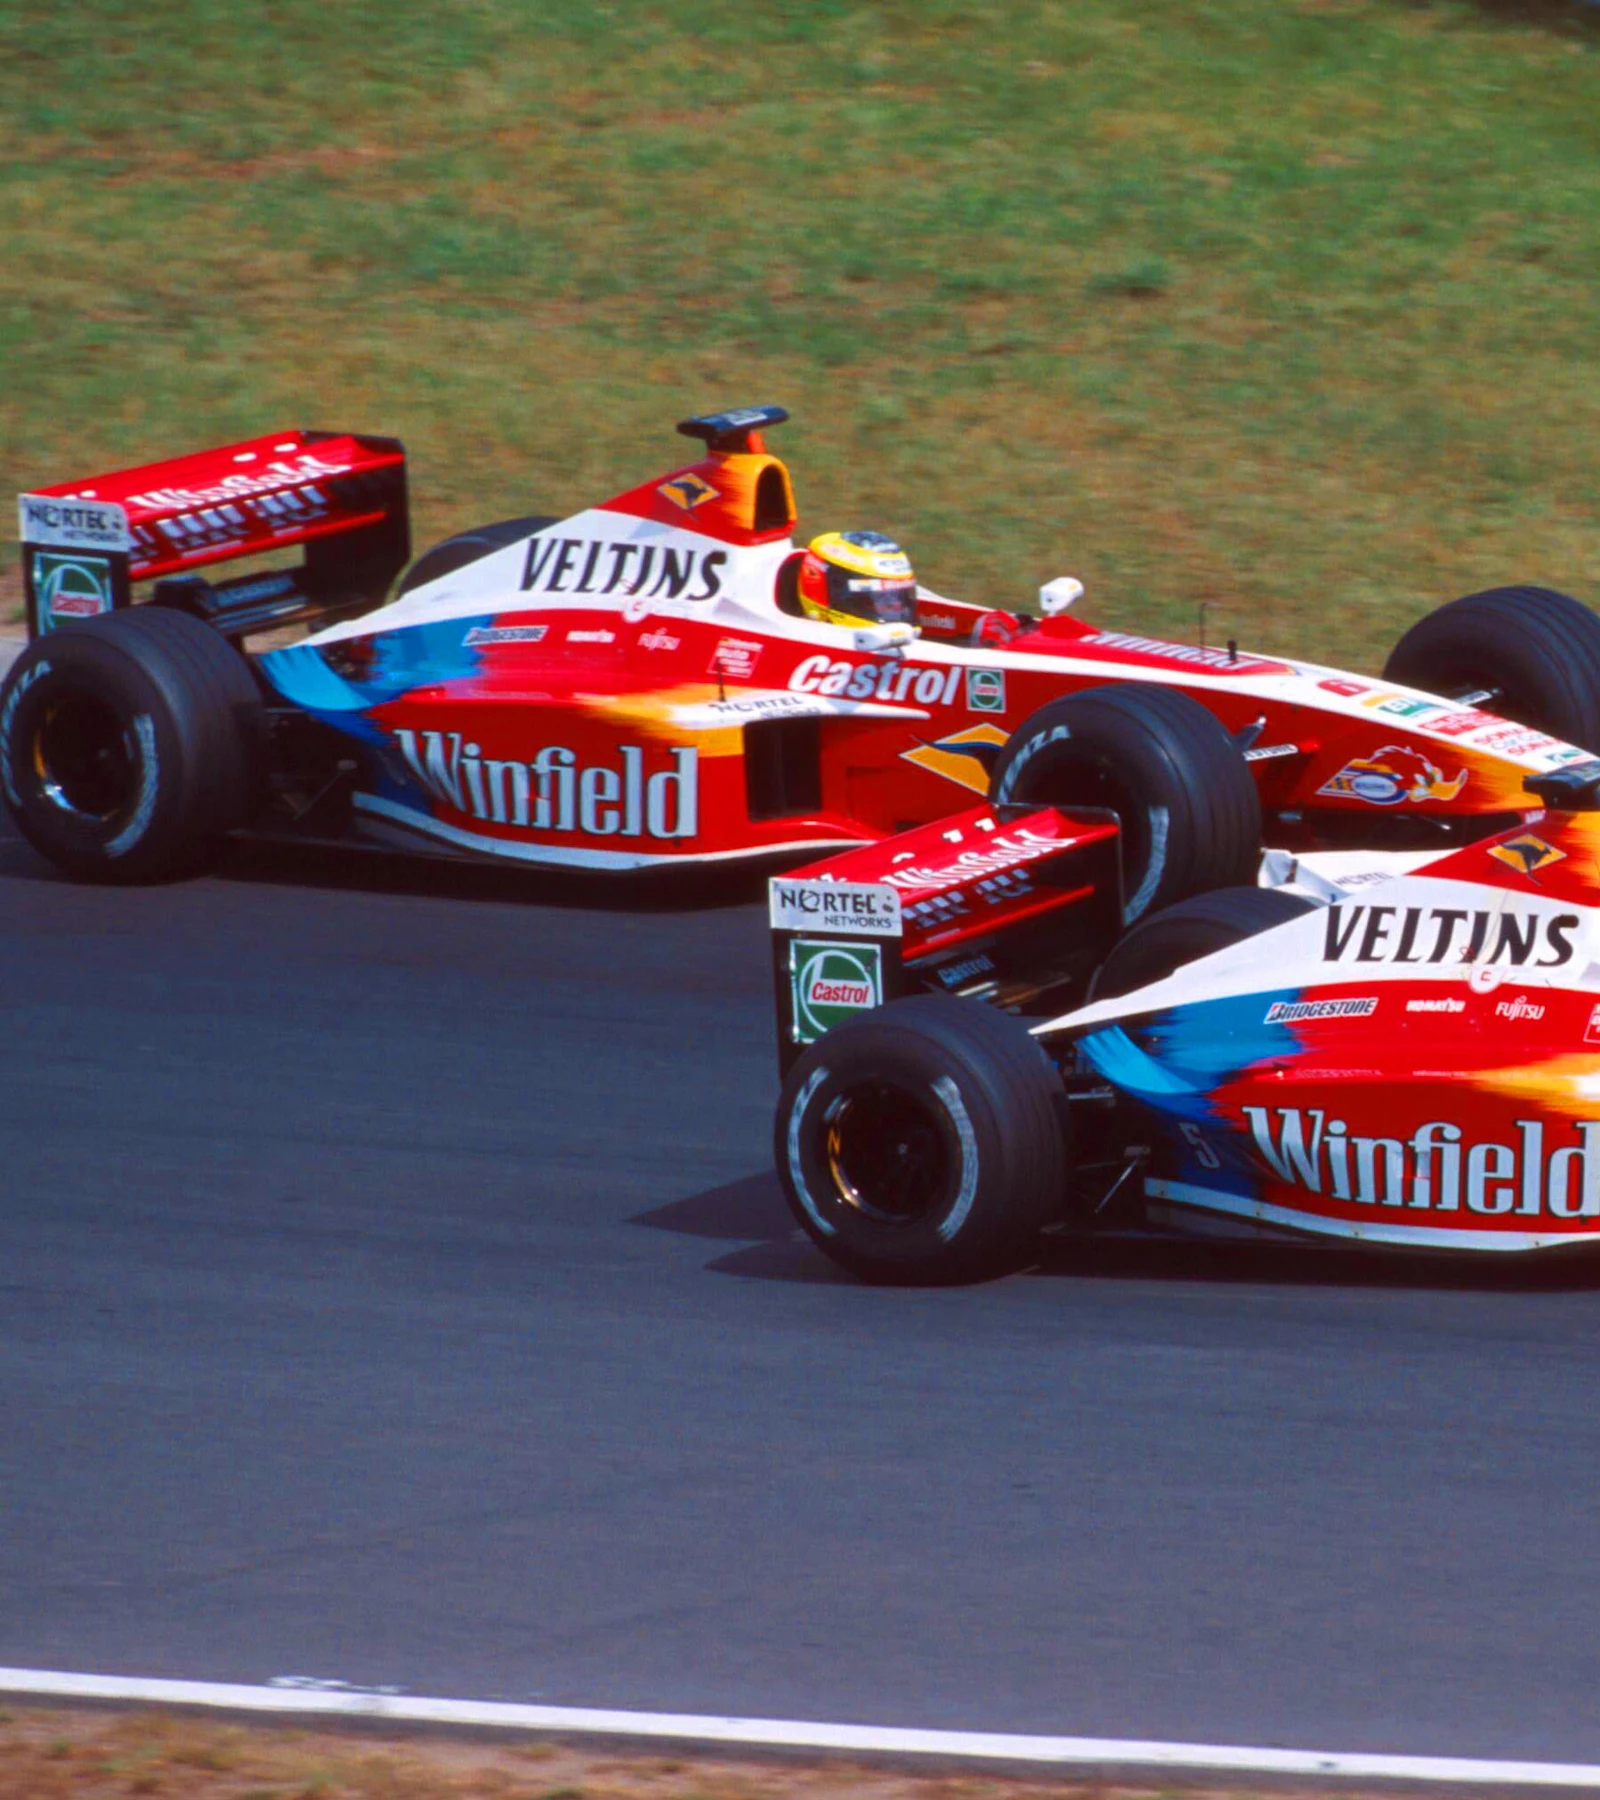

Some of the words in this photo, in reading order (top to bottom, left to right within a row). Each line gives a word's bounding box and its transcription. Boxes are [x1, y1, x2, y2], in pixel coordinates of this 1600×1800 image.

[519, 537, 728, 602] VELTINS
[788, 655, 963, 705] Castrol
[393, 729, 698, 838] Winfield
[781, 888, 876, 914] NORTEL
[824, 915, 892, 928] NETWORKS
[1323, 904, 1580, 968] VELTINS
[812, 981, 869, 1004] Castrol
[1406, 998, 1465, 1012] KOMATSU
[1267, 998, 1376, 1022] BRIDGESTONE
[1496, 1002, 1545, 1021] FUJITSU
